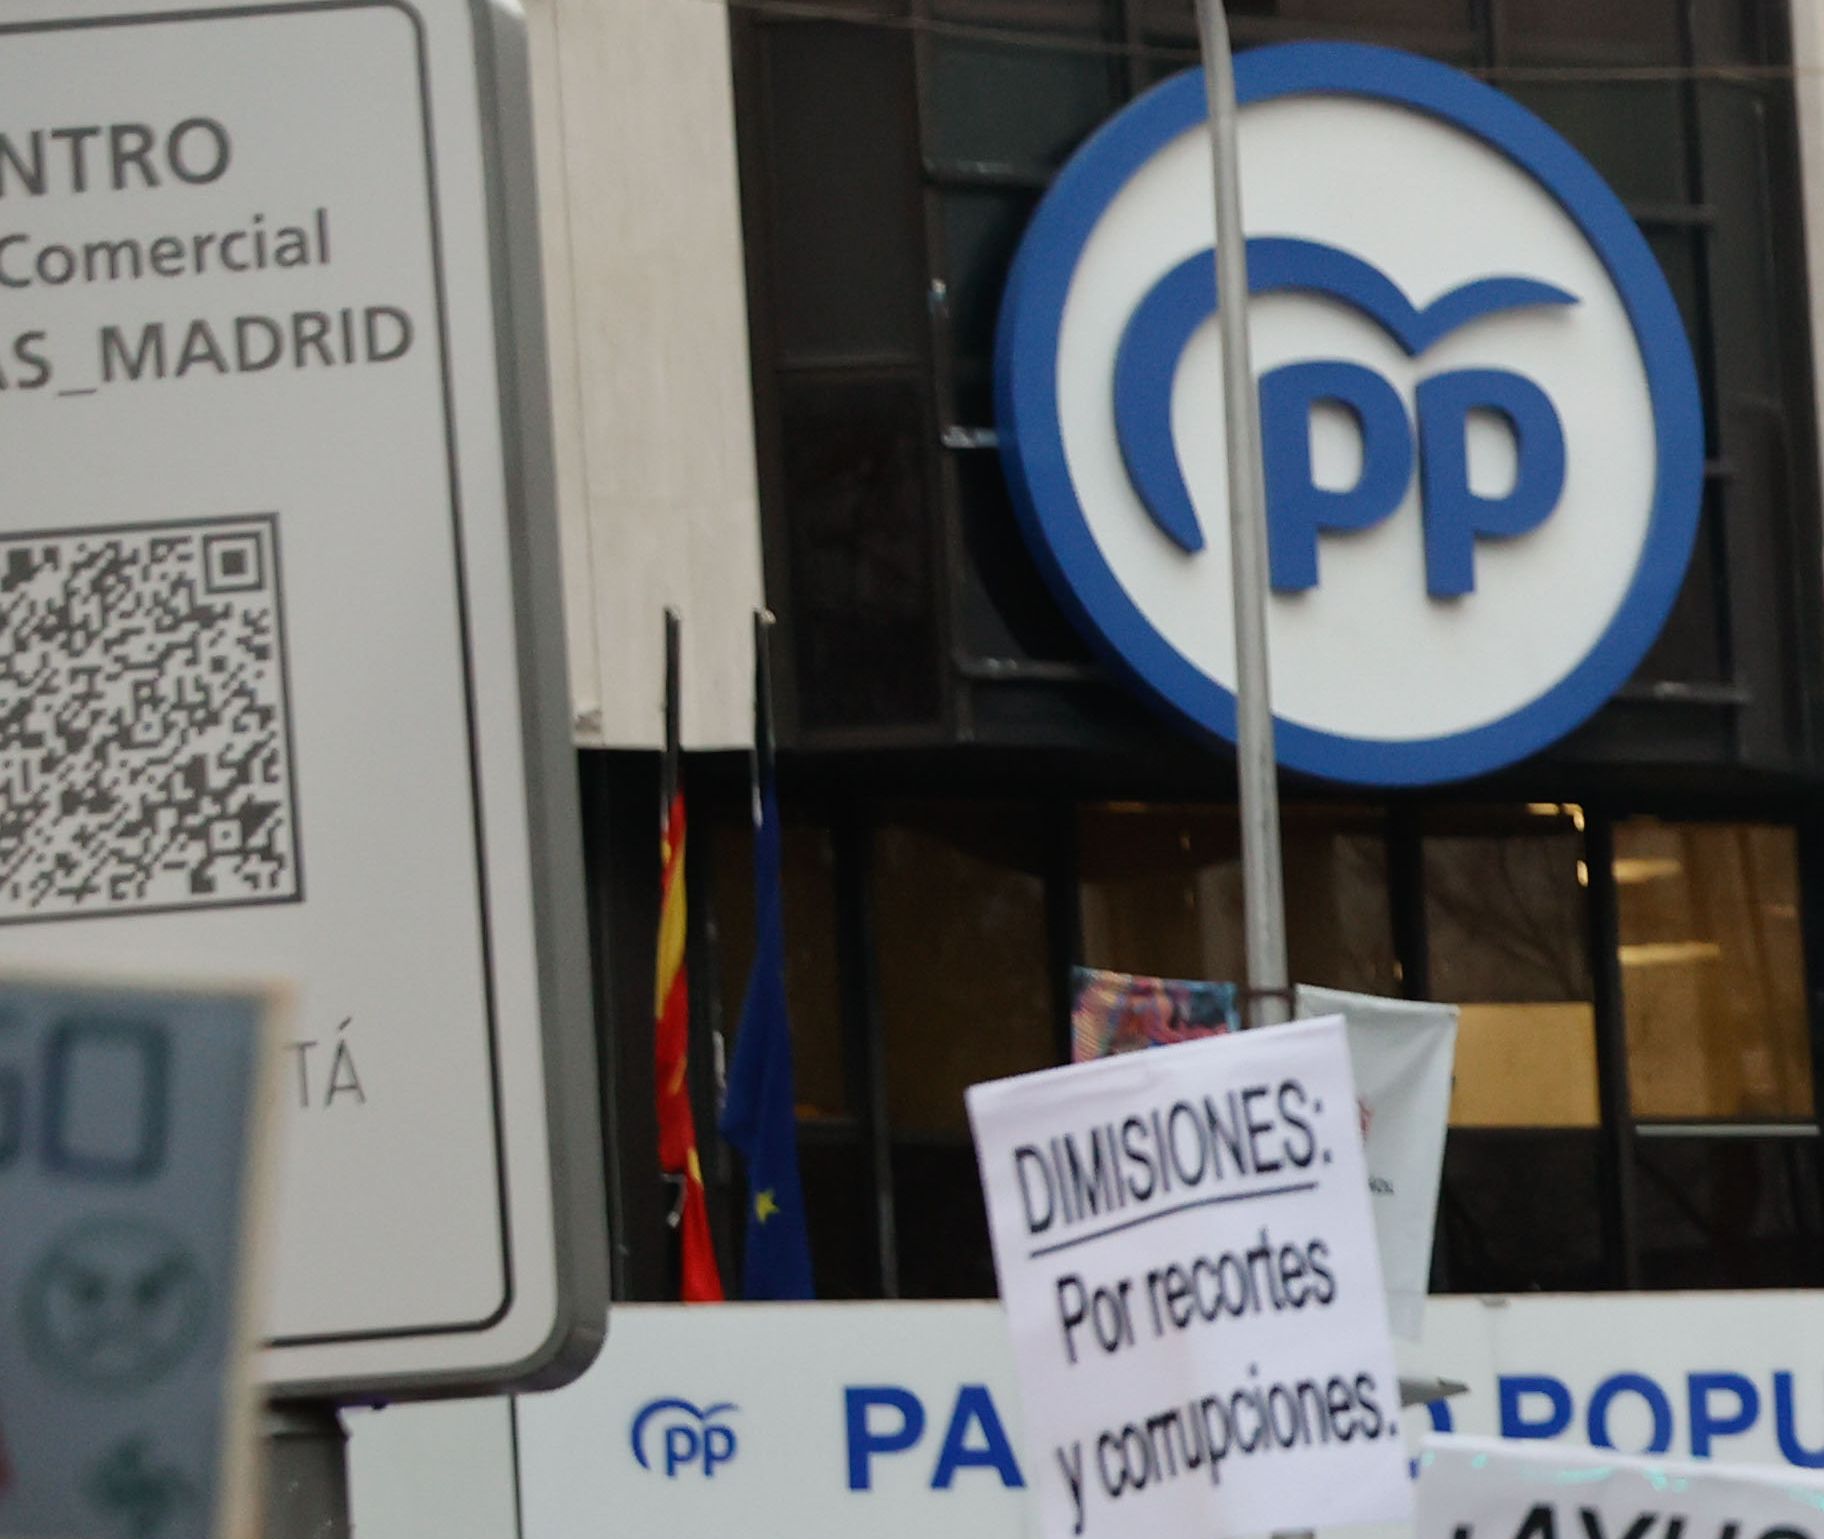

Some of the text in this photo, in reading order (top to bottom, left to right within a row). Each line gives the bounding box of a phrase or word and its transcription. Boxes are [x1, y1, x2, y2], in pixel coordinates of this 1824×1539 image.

[0, 208, 331, 288] Comercial
[0, 305, 414, 397] S_MADRID
[1014, 1078, 1332, 1237] DIMISIONES:
[1057, 1230, 1337, 1365] Por recortes
[1056, 1440, 1086, 1537] y
[1099, 1362, 1397, 1502] corrupciones.
